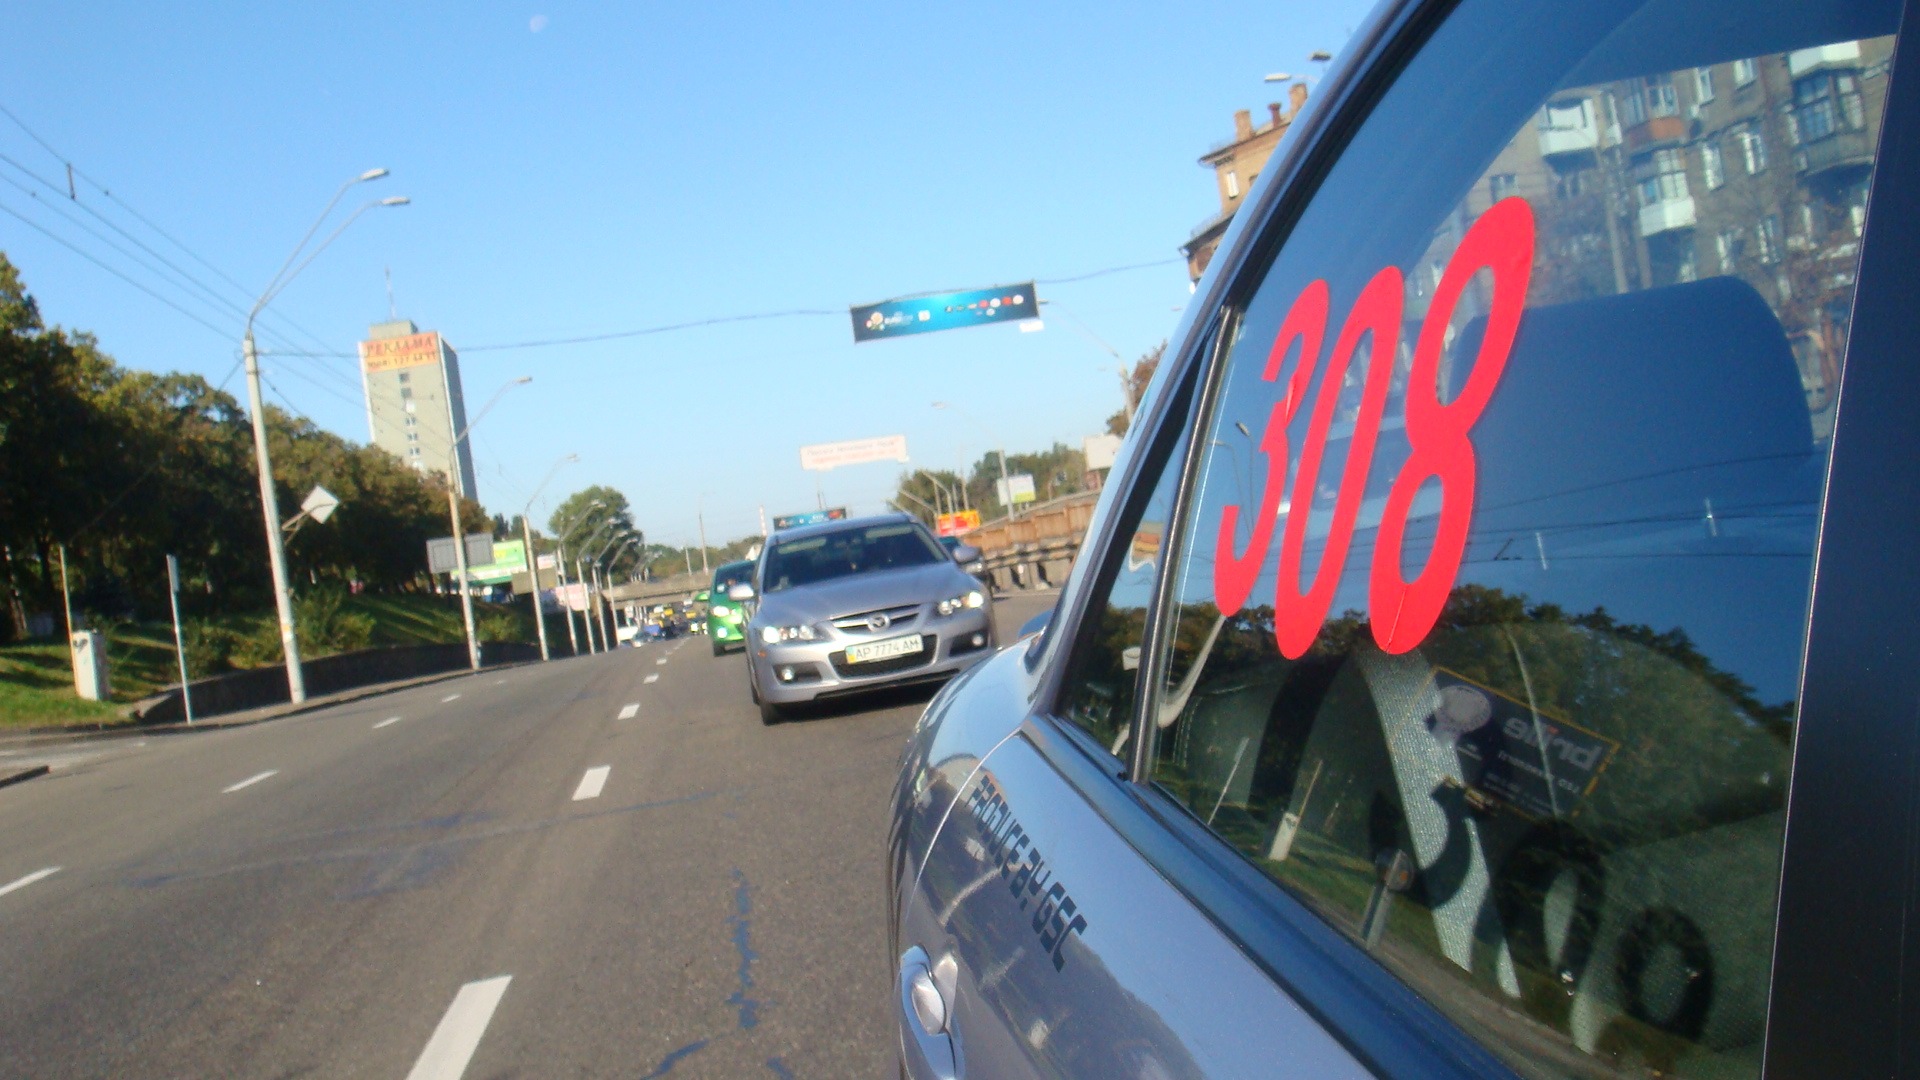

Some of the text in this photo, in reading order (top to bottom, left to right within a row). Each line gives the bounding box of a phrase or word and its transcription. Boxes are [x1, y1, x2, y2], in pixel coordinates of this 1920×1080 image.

[1214, 196, 1535, 660] 308
[855, 638, 919, 660] AP 7774 AM
[965, 774, 1030, 879] PRODUCE
[1032, 881, 1088, 973] GSC
